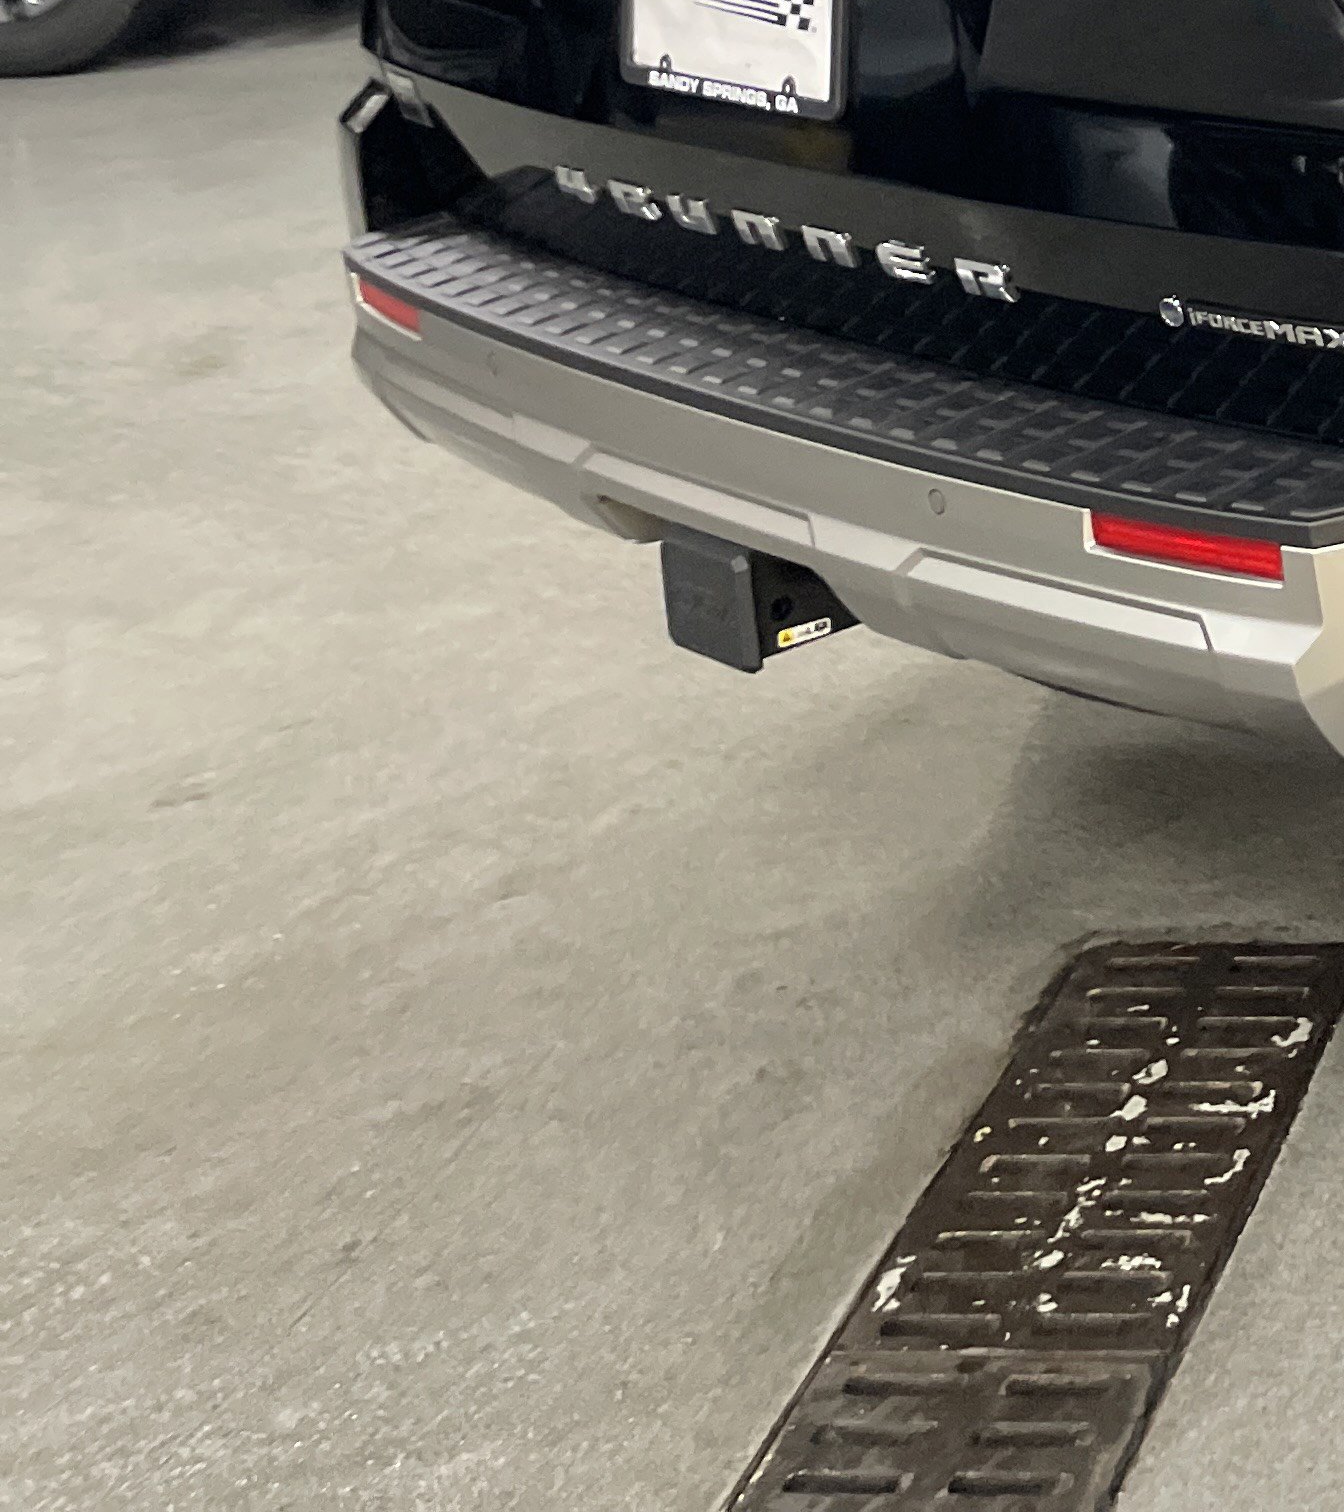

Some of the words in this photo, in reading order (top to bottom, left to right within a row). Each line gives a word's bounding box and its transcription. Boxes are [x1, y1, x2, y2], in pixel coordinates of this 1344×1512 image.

[648, 70, 700, 94] SANDY
[701, 80, 771, 112] SPRINGS,
[773, 94, 799, 115] GA
[553, 163, 1021, 305] 4RUNNER
